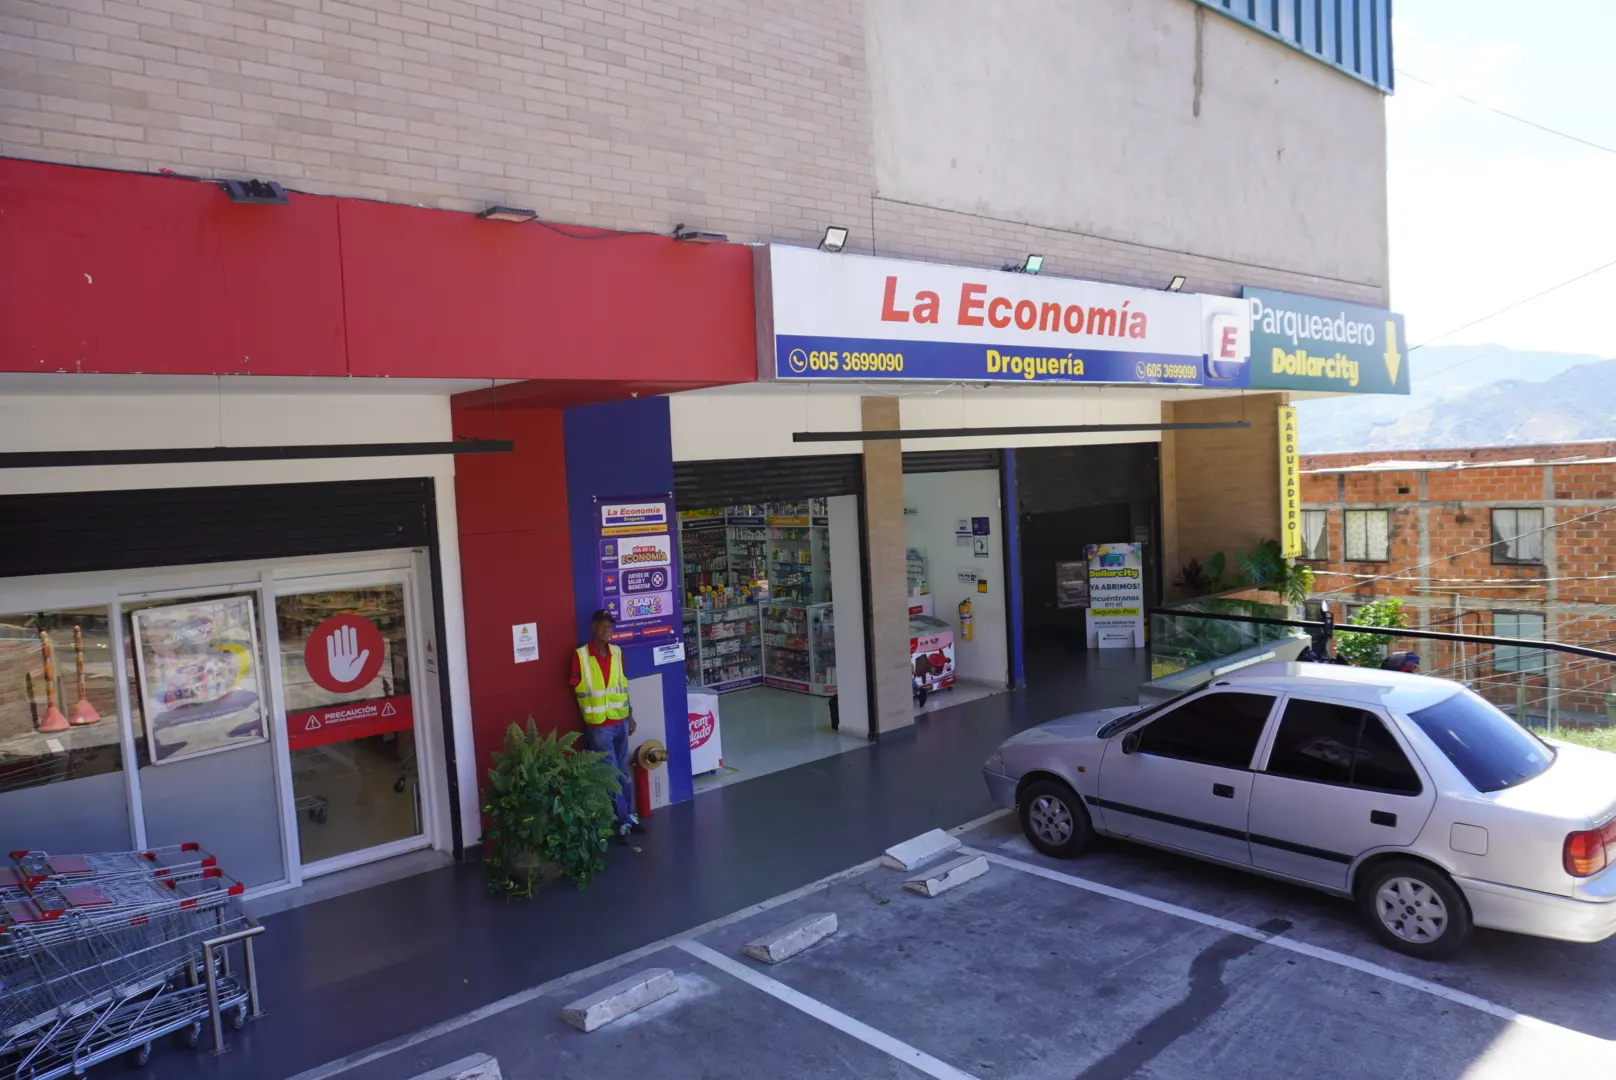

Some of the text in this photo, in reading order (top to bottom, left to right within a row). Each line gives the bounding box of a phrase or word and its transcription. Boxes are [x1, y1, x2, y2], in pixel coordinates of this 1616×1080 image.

[881, 276, 1147, 339] La Economía
[1250, 298, 1375, 346] Parqueadero
[1220, 326, 1238, 358] E
[809, 351, 904, 372] 605 3699090
[986, 349, 1084, 379] Droguería
[1271, 347, 1359, 387] Dollarcity
[1146, 364, 1197, 380] 605 3699090
[1285, 411, 1296, 530] PARQUEADERO
[607, 506, 660, 516] La Economía
[621, 550, 667, 565] ECONOMÍA
[1089, 568, 1139, 578] Dollarcity
[633, 597, 655, 607] BABY
[627, 604, 662, 617] VIERNES
[325, 705, 376, 719] PRECAUCIÓN
[688, 715, 709, 731] rem
[689, 725, 712, 742] lado
